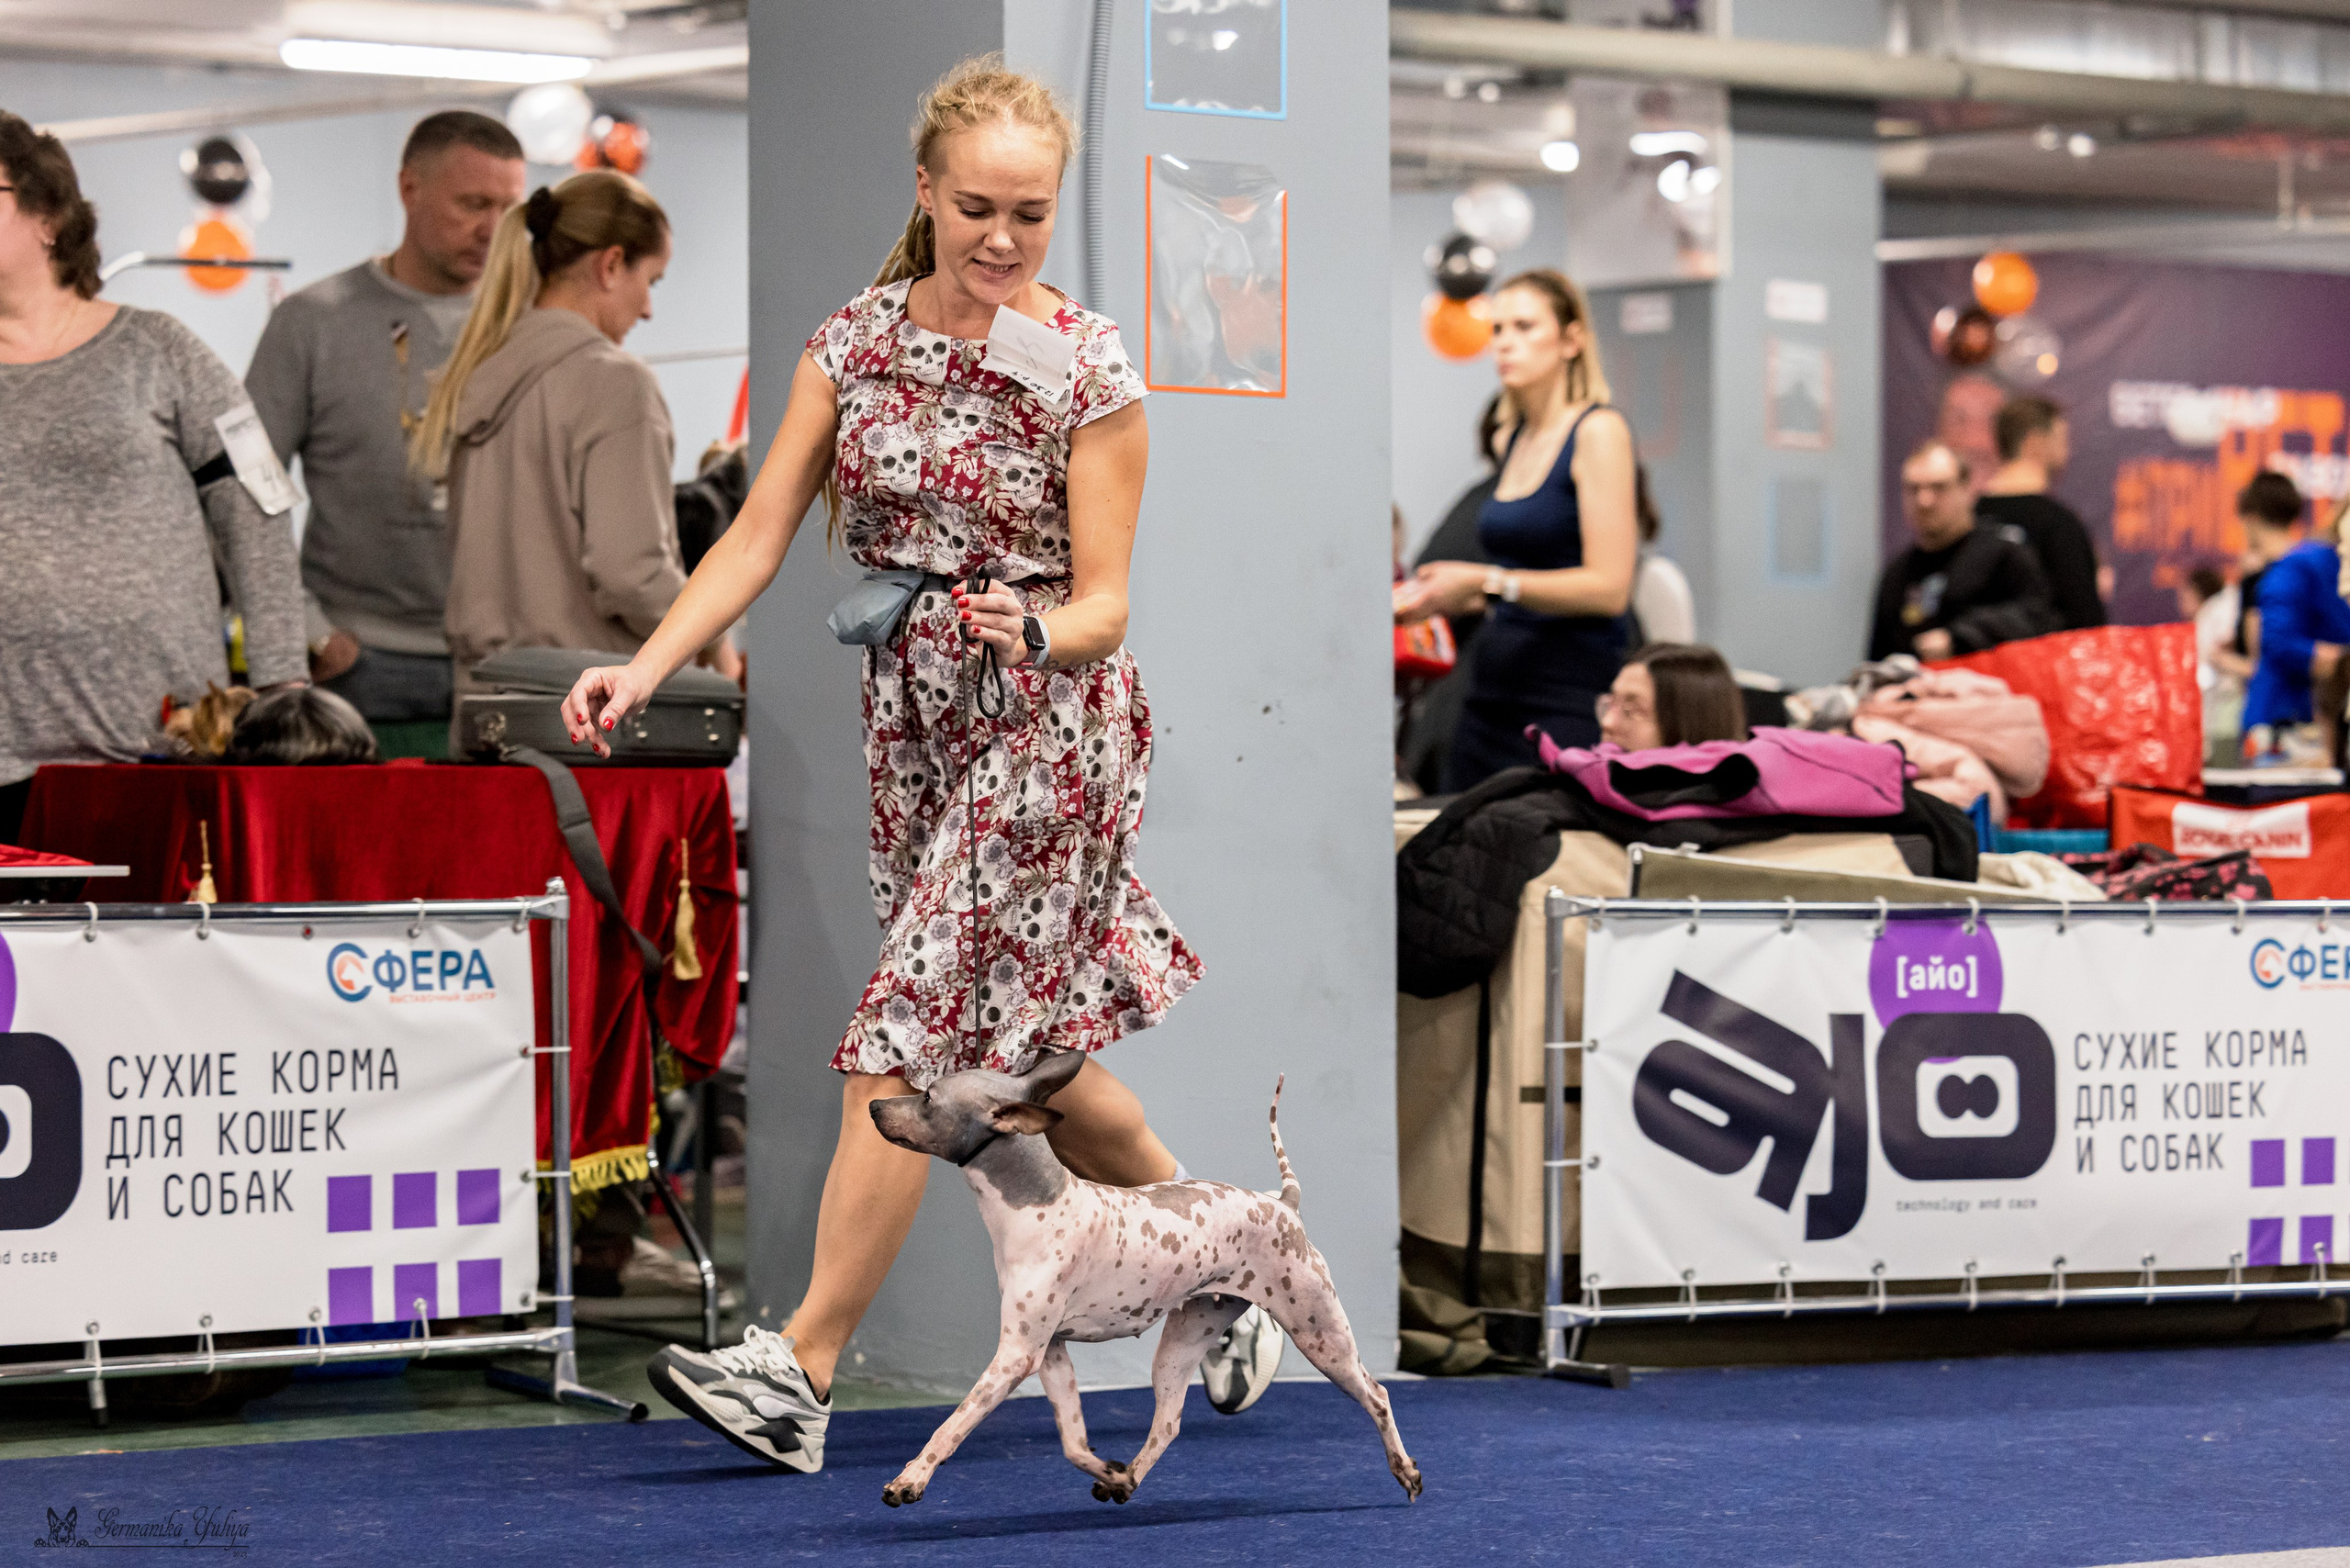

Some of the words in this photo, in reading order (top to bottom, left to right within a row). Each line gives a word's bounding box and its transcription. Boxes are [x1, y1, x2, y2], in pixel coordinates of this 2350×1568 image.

[326, 943, 496, 1002] СФЕРА
[2249, 937, 2350, 990] СФЕ
[464, 991, 496, 1002] ЦЕНТР
[107, 1052, 238, 1100] СУХИЕ
[273, 1048, 399, 1094] КОРМА
[2074, 1032, 2178, 1071] СУХИЕ
[2205, 1029, 2308, 1068] КОРМА
[2074, 1084, 2136, 1129] ДЛЯ
[2163, 1081, 2266, 1120] КОШЕК
[106, 1114, 184, 1170] ДЛЯ
[218, 1107, 347, 1156] КОШЕК
[2076, 1137, 2094, 1174] И
[2121, 1132, 2224, 1172] СОБАК
[107, 1176, 129, 1221] И
[163, 1169, 294, 1217] СОБАК
[1896, 1197, 1971, 1214] technology
[1979, 1197, 2001, 1210] and
[21, 1251, 58, 1264] care
